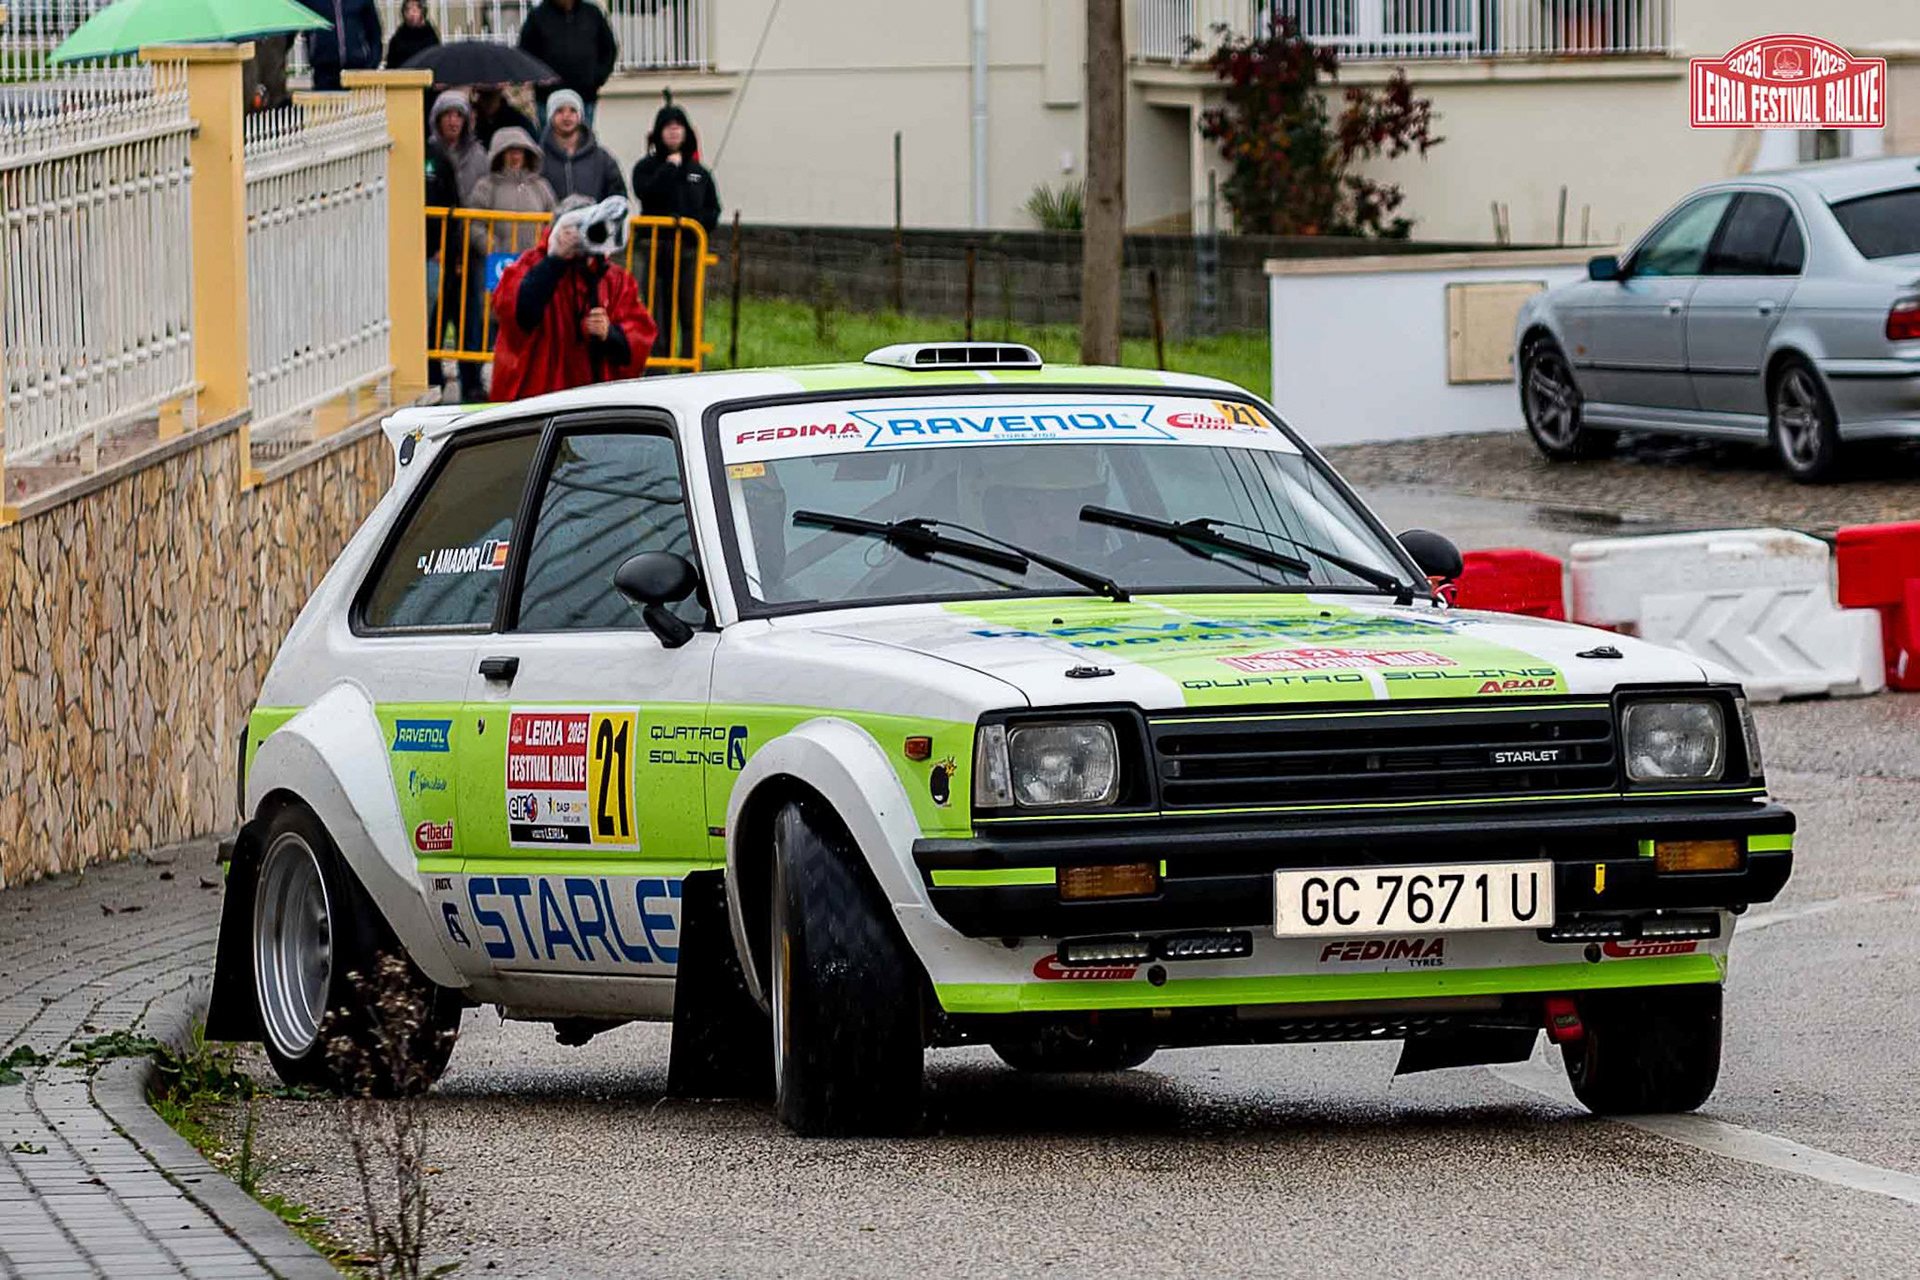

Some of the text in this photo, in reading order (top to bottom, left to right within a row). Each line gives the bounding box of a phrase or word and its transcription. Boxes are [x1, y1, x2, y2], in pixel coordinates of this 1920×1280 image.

[887, 413, 1137, 436] RAVENOL
[1221, 403, 1263, 427] 21
[736, 422, 861, 445] FEDIMA
[433, 547, 481, 574] AMADOR
[1182, 668, 1557, 690] QUATRO SOLING
[1477, 678, 1555, 694] ABAD
[398, 727, 446, 744] RAVENOL
[525, 720, 587, 746] LEIRIA 2025
[650, 726, 726, 741] QUATRO
[649, 750, 725, 765] SOLING
[1495, 749, 1559, 764] STARLET
[509, 754, 586, 783] FESTIVAL RALLYE
[595, 718, 630, 837] 21
[1301, 872, 1538, 926] GC 7671 U
[1320, 937, 1445, 962] FEDIMA
[1409, 957, 1445, 967] TYRES
